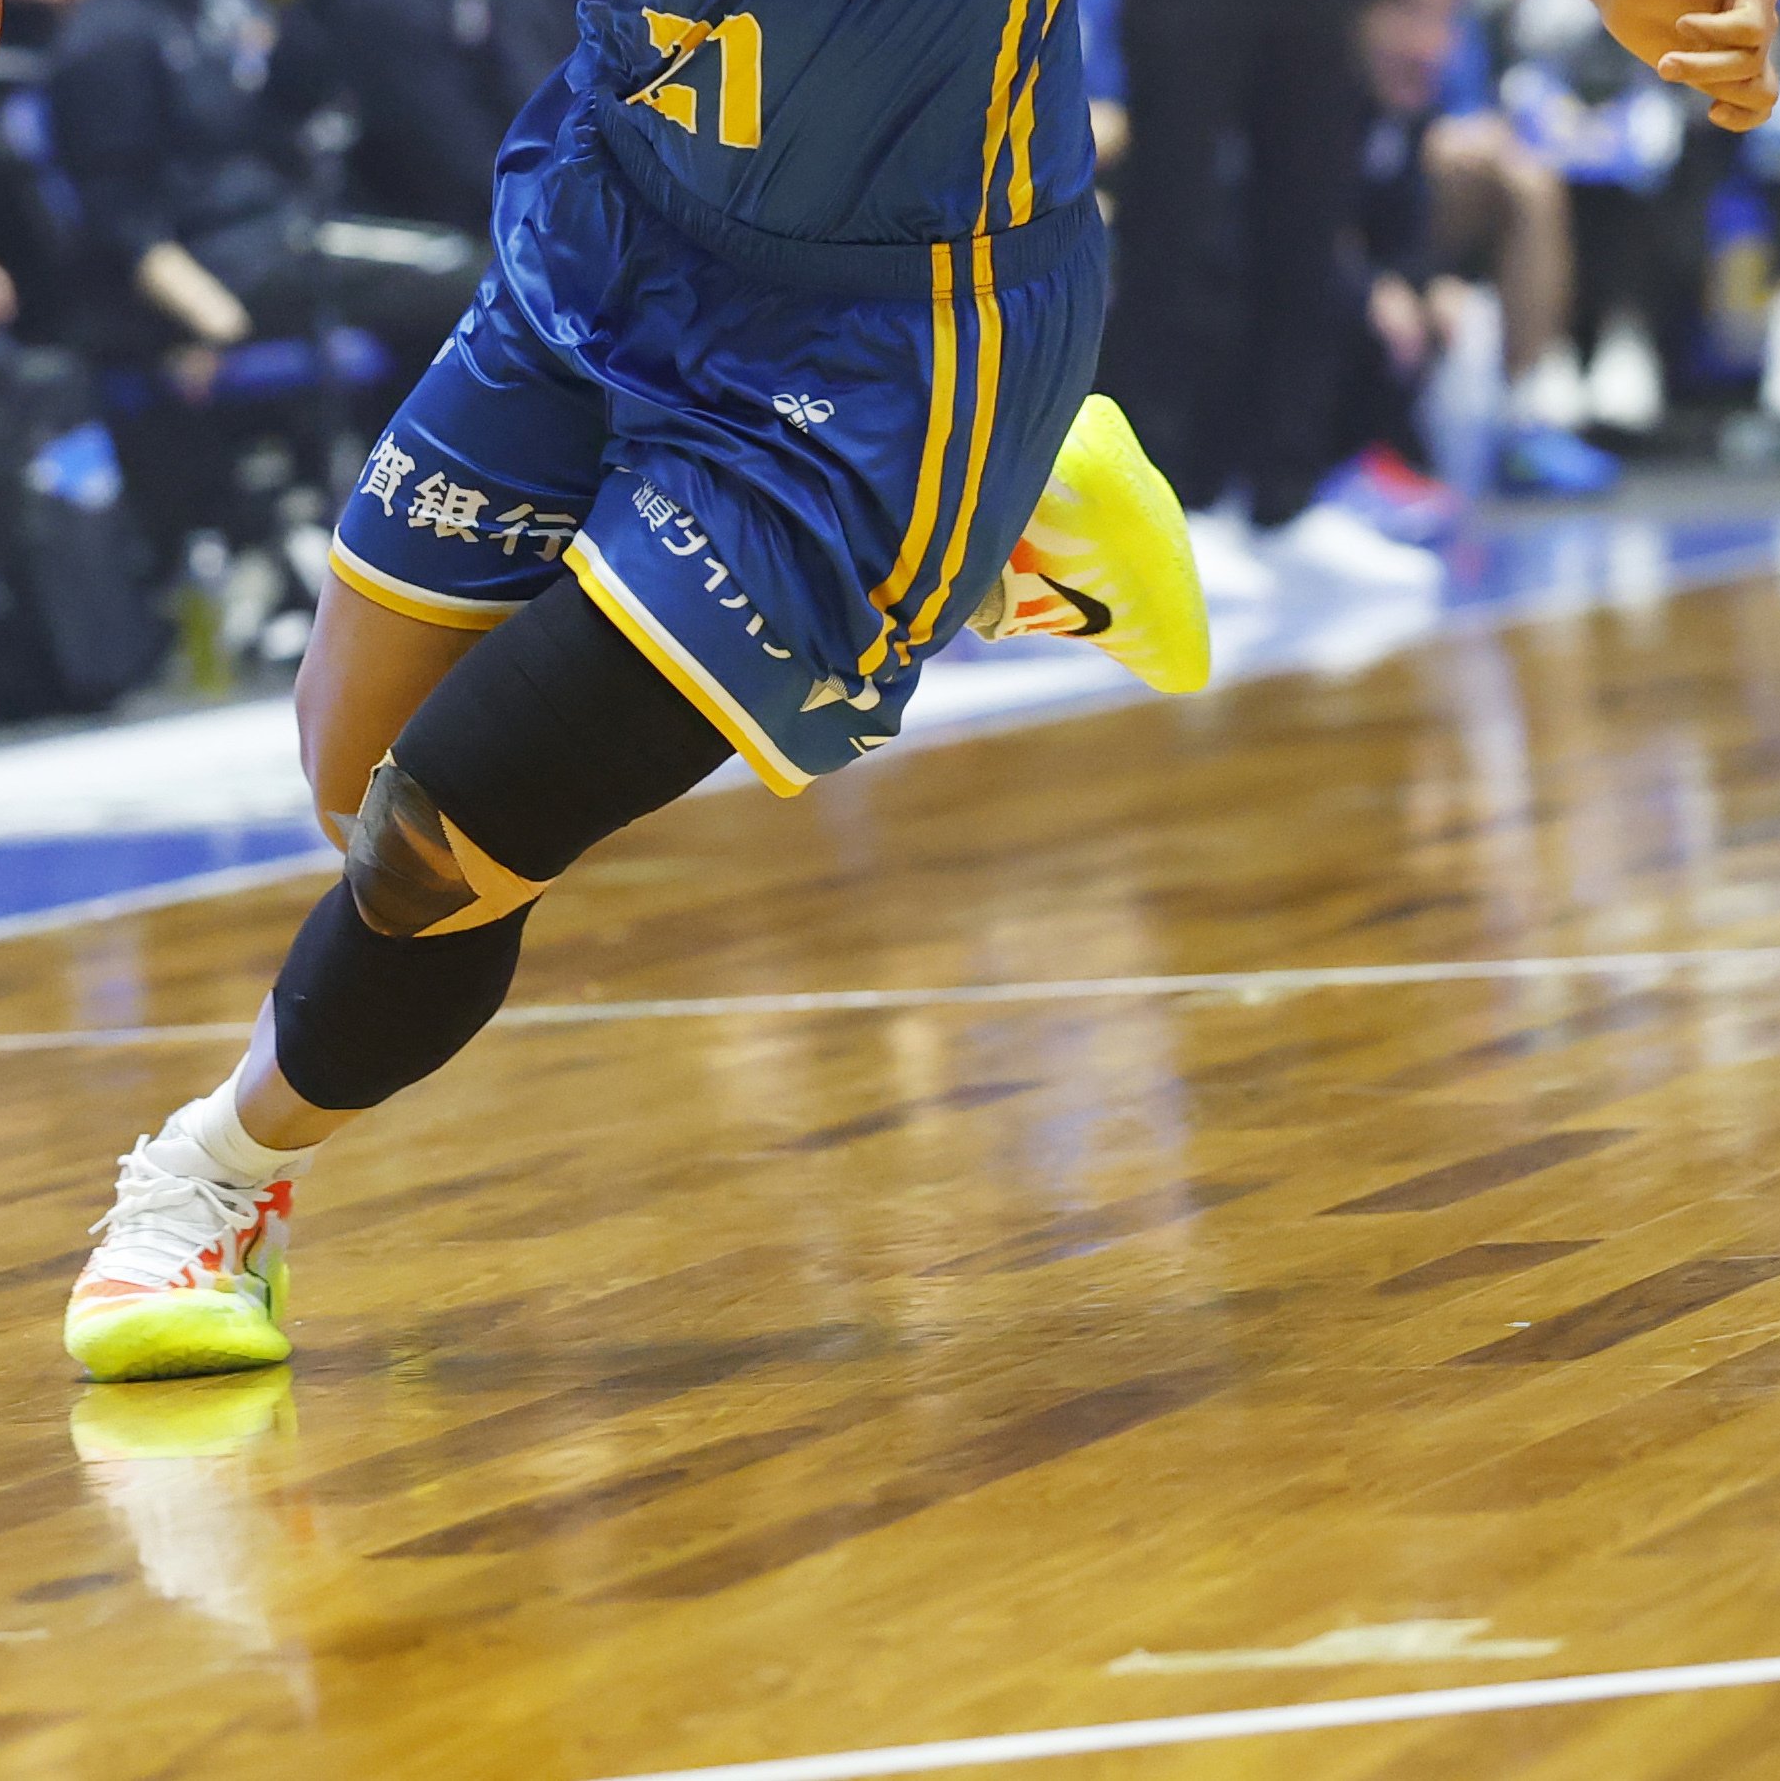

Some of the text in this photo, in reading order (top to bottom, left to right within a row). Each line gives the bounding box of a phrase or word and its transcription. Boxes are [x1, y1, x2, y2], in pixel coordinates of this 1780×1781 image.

[625, 5, 763, 150] 21
[358, 431, 577, 563] 賀銀行
